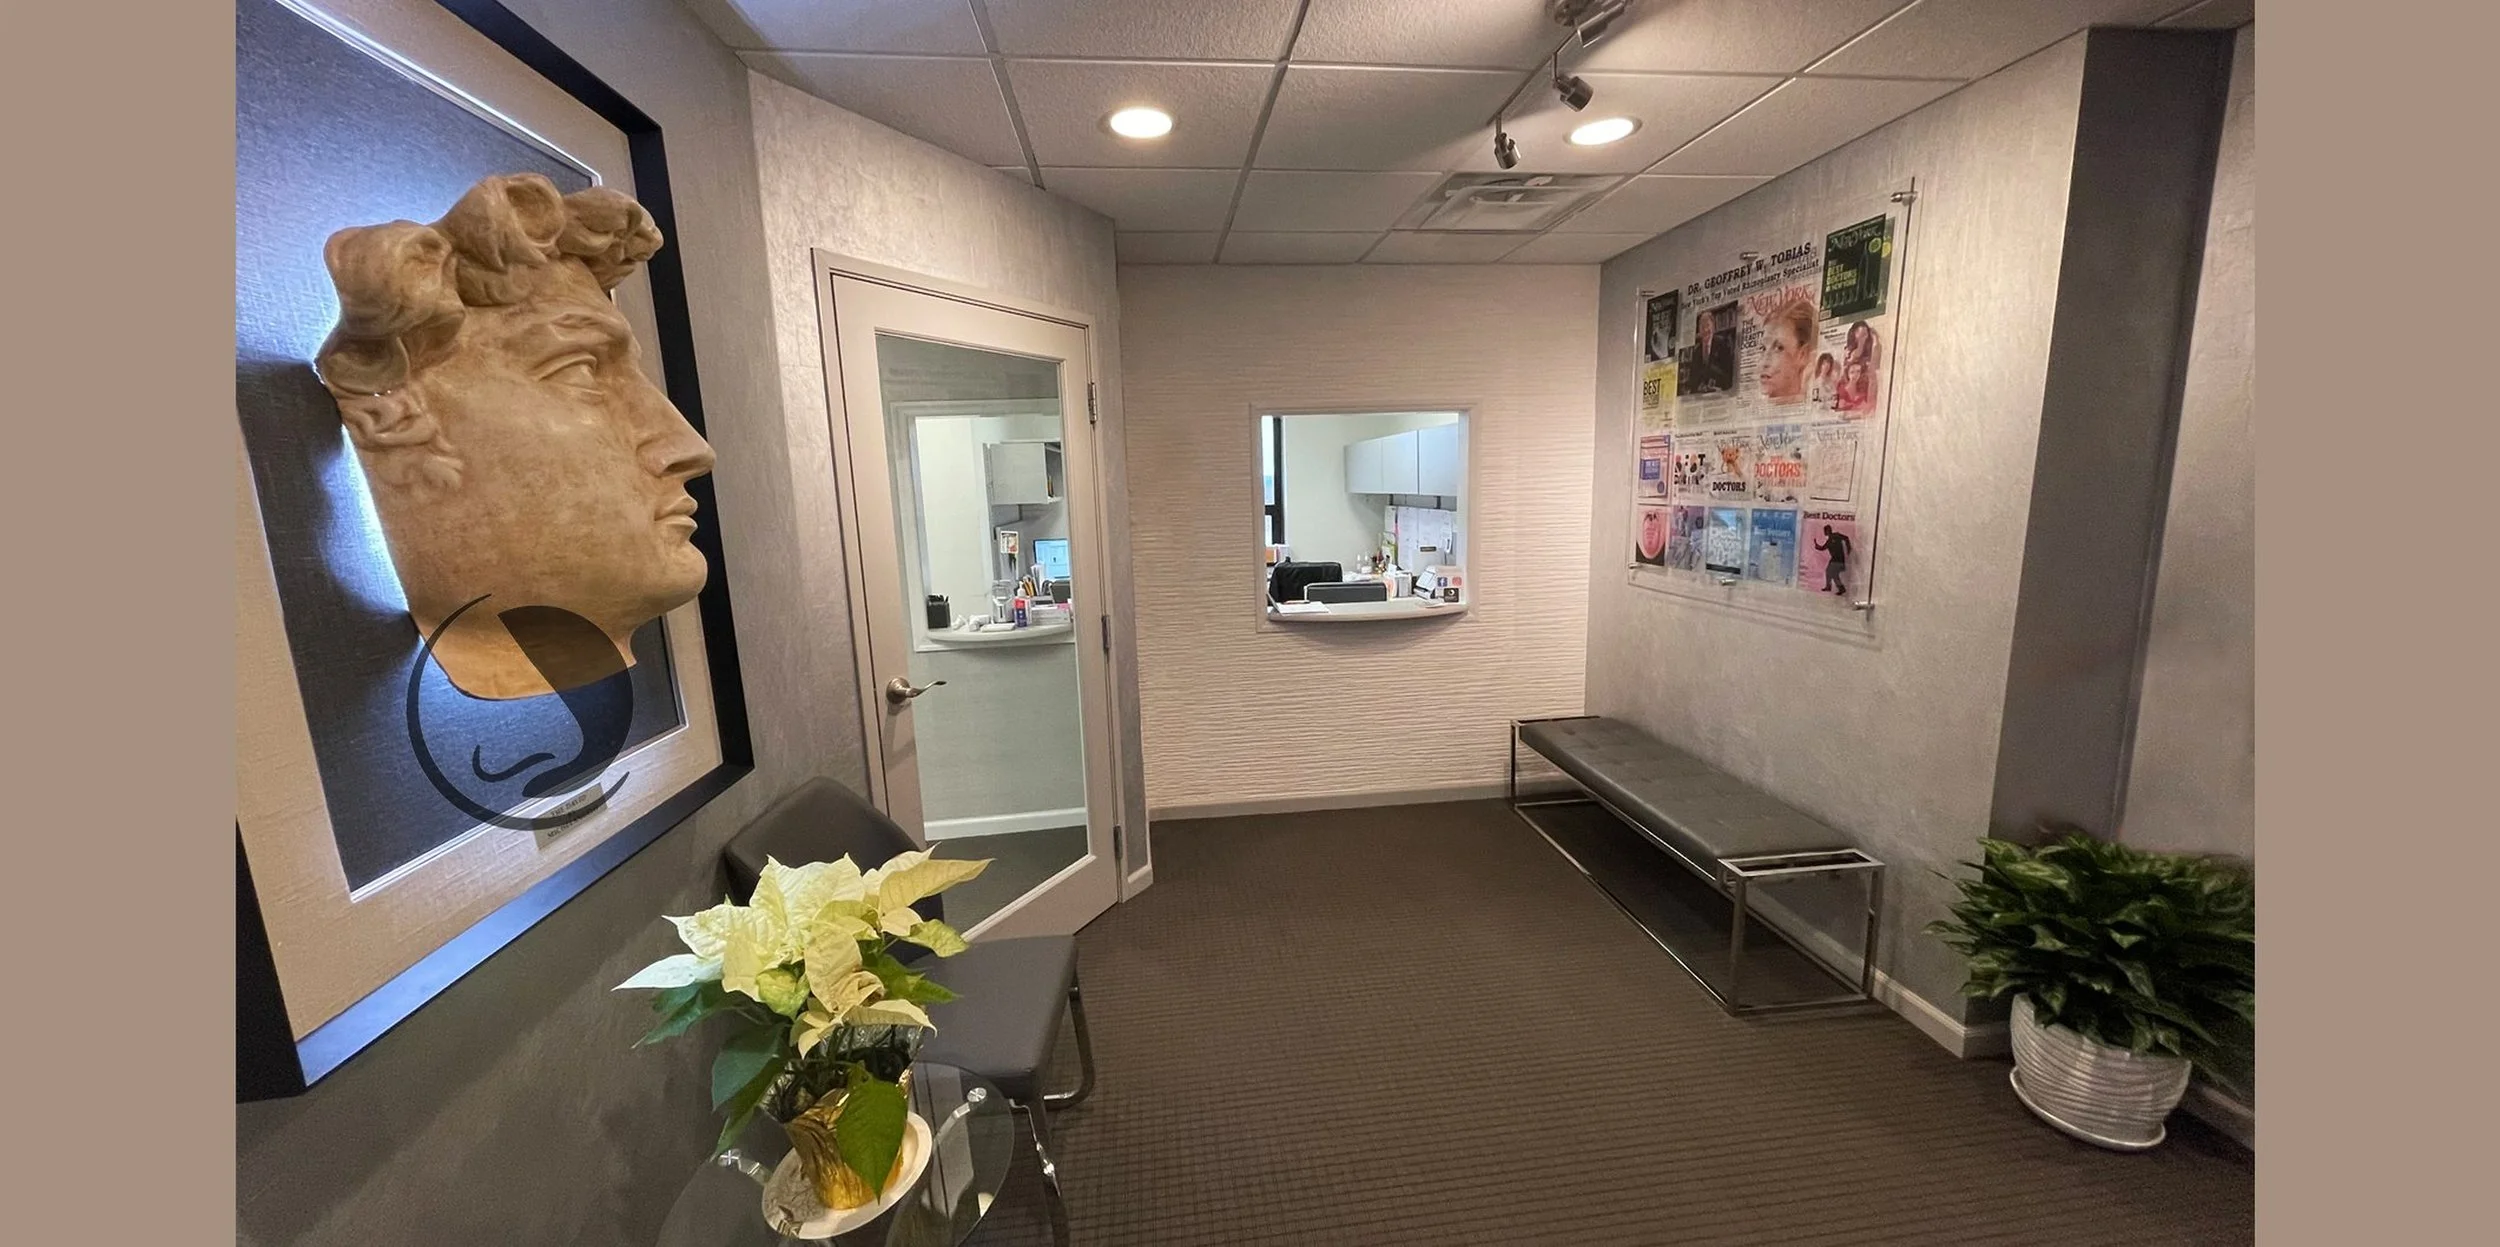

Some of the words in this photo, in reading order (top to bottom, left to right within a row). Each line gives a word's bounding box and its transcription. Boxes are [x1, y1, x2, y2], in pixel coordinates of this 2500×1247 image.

[1687, 282, 1702, 296] DR.
[1704, 262, 1753, 290] GEOFFREY
[1770, 242, 1812, 266] TOBIAS
[1710, 289, 1722, 303] Top
[1782, 258, 1820, 277] Specialist
[1643, 378, 1661, 396] BEST
[1754, 462, 1801, 478] DOCTORS
[1712, 481, 1747, 493] DOCTORS
[1803, 511, 1821, 521] Best
[1822, 511, 1856, 522] Doctors
